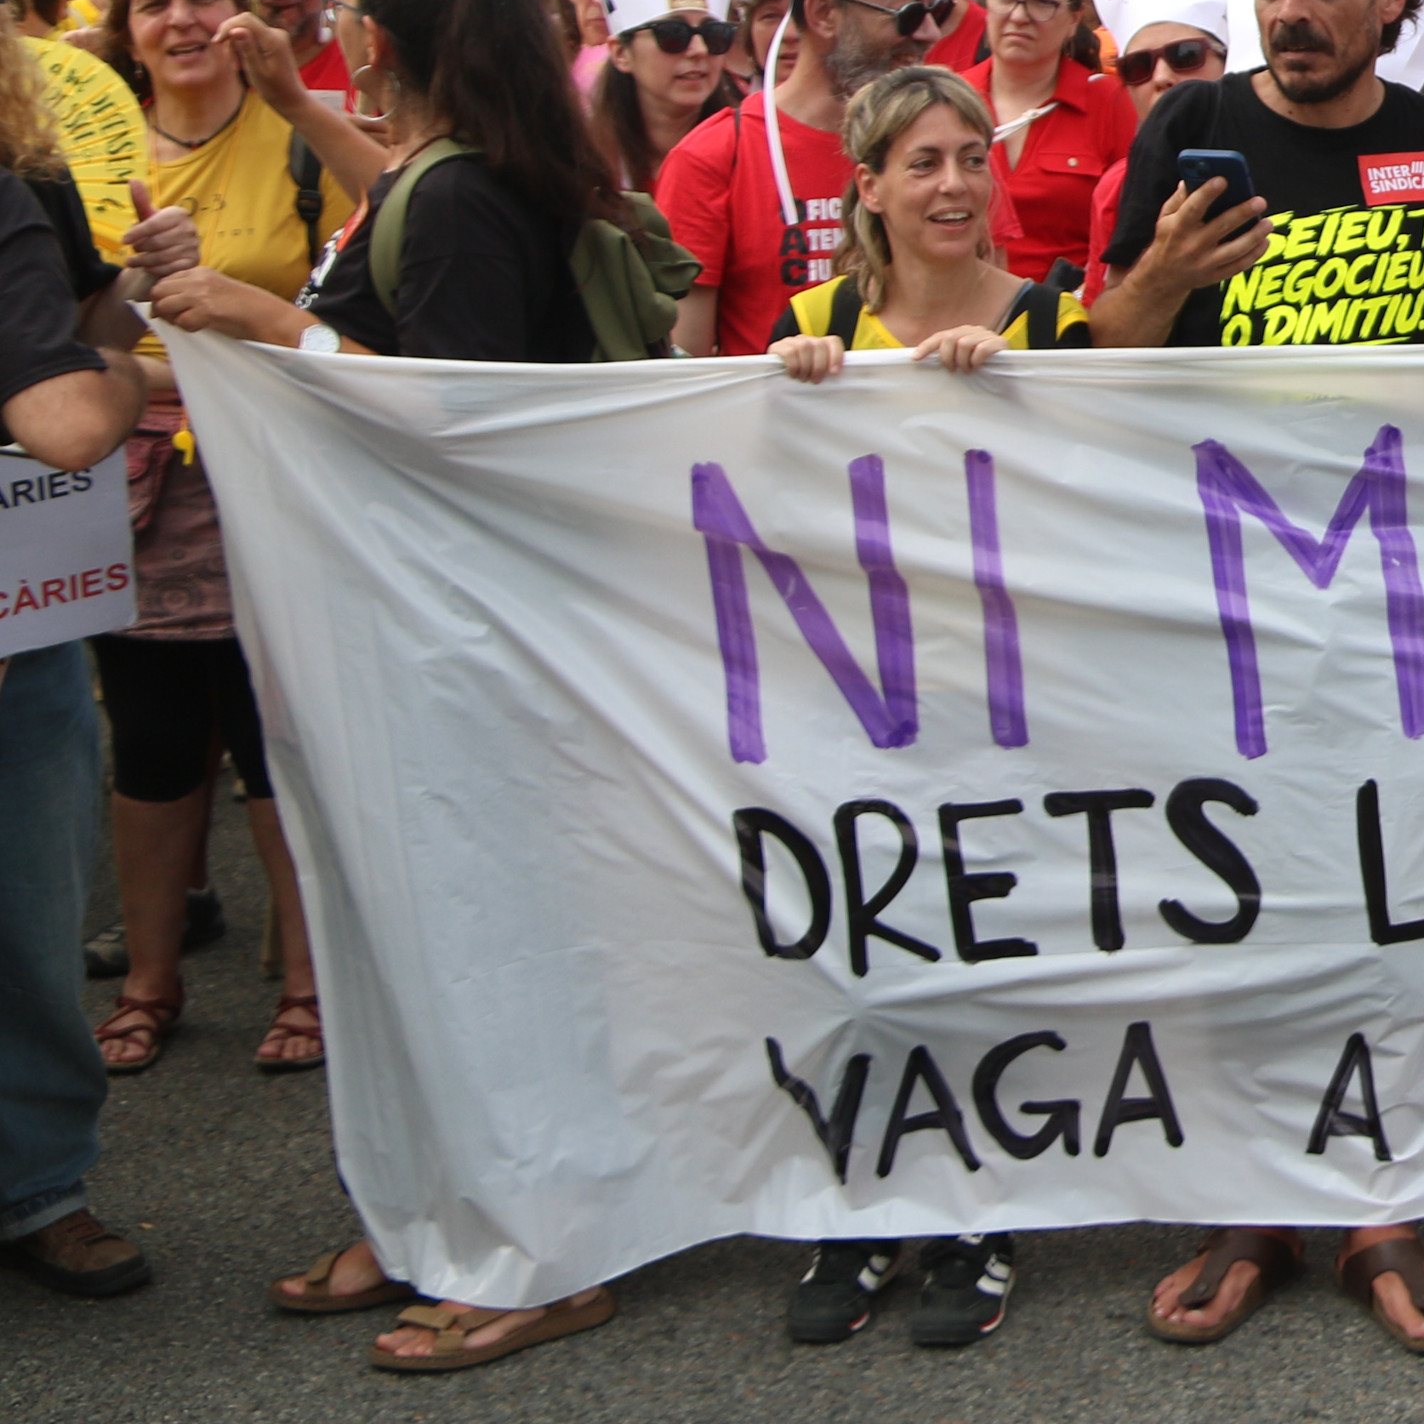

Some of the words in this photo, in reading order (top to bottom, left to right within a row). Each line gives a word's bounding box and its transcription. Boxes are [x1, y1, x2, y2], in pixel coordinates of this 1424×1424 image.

[1367, 164, 1412, 181] INTER
[1221, 313, 1252, 346] O
[691, 448, 1029, 764] NI
[731, 777, 1262, 975] DRETS
[766, 1020, 1184, 1184] VAGA
[1305, 1032, 1394, 1161] A
